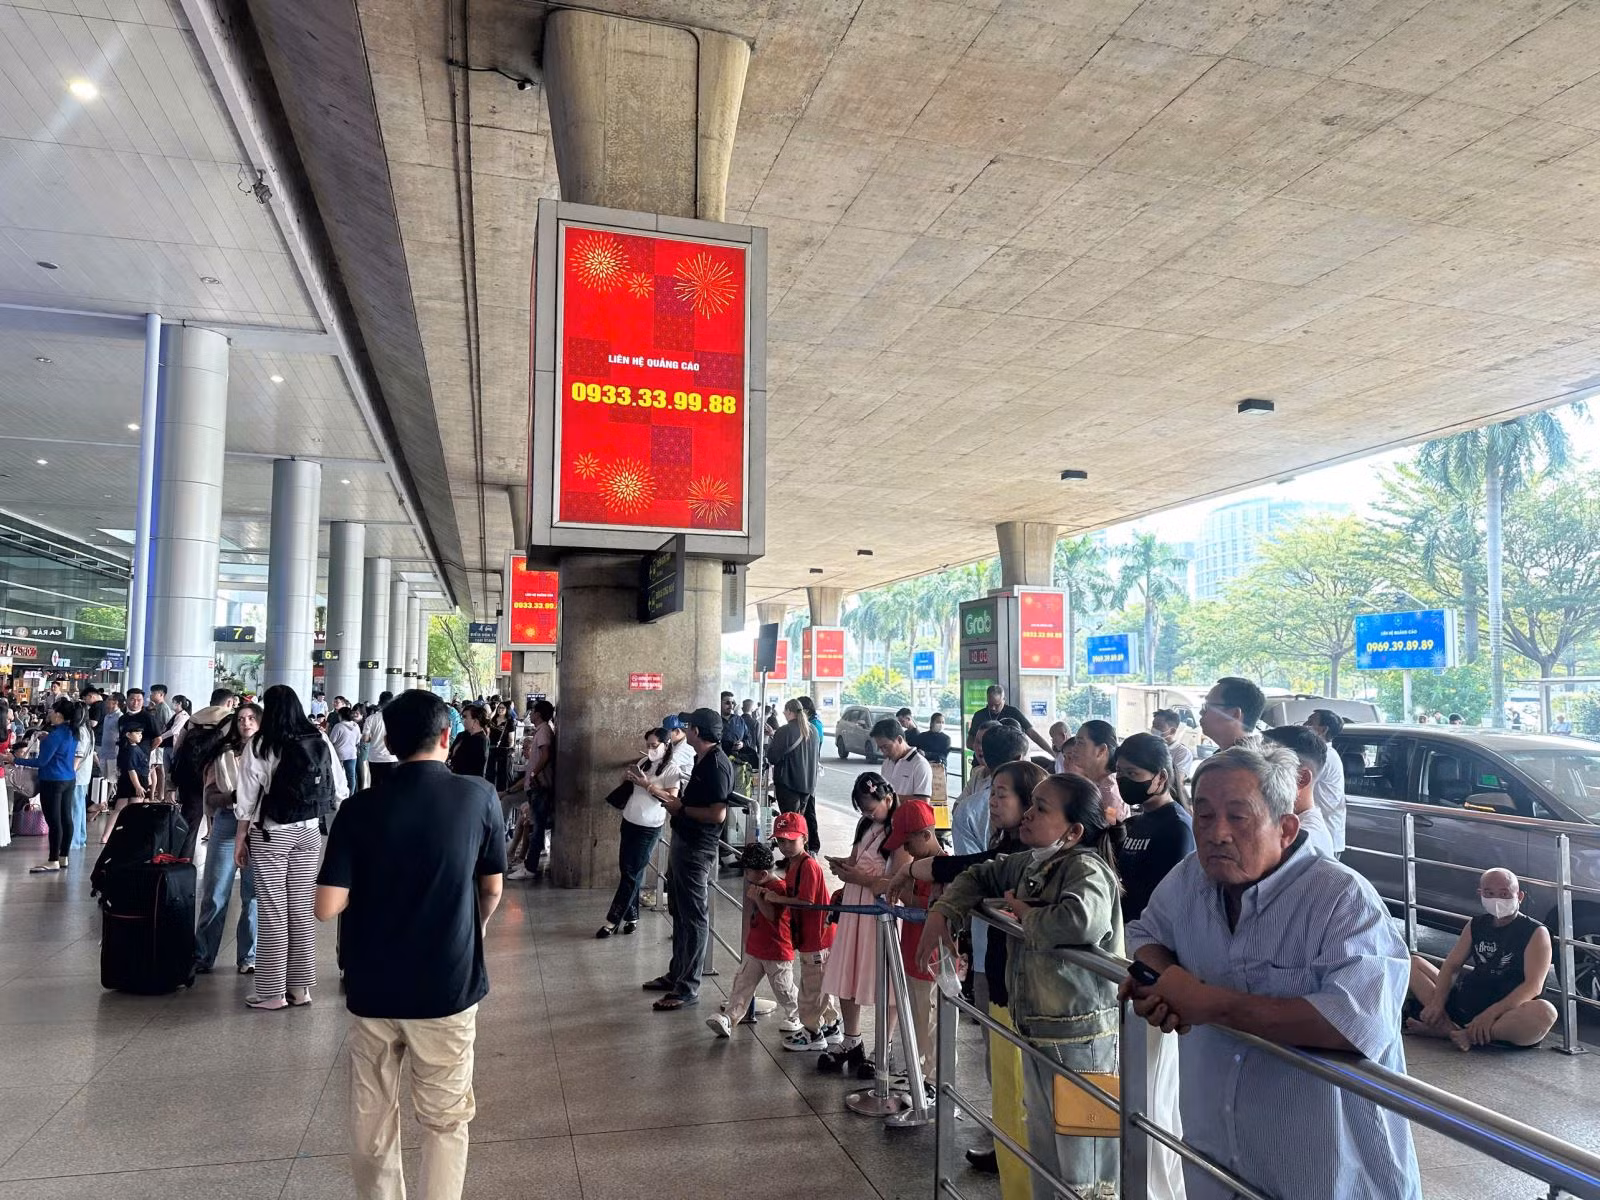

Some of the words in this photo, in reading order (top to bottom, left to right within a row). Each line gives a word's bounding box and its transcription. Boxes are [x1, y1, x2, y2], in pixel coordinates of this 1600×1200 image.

[608, 354, 630, 364] LIÊN
[632, 356, 644, 367] HỆ
[647, 357, 678, 369] QUẢNG
[681, 360, 700, 371] CÁO
[571, 382, 737, 414] 0933.33.99.88
[966, 610, 992, 635] Grab
[233, 628, 243, 640] 7
[1367, 640, 1434, 652] 0969.39.89.89
[325, 650, 332, 660] 6
